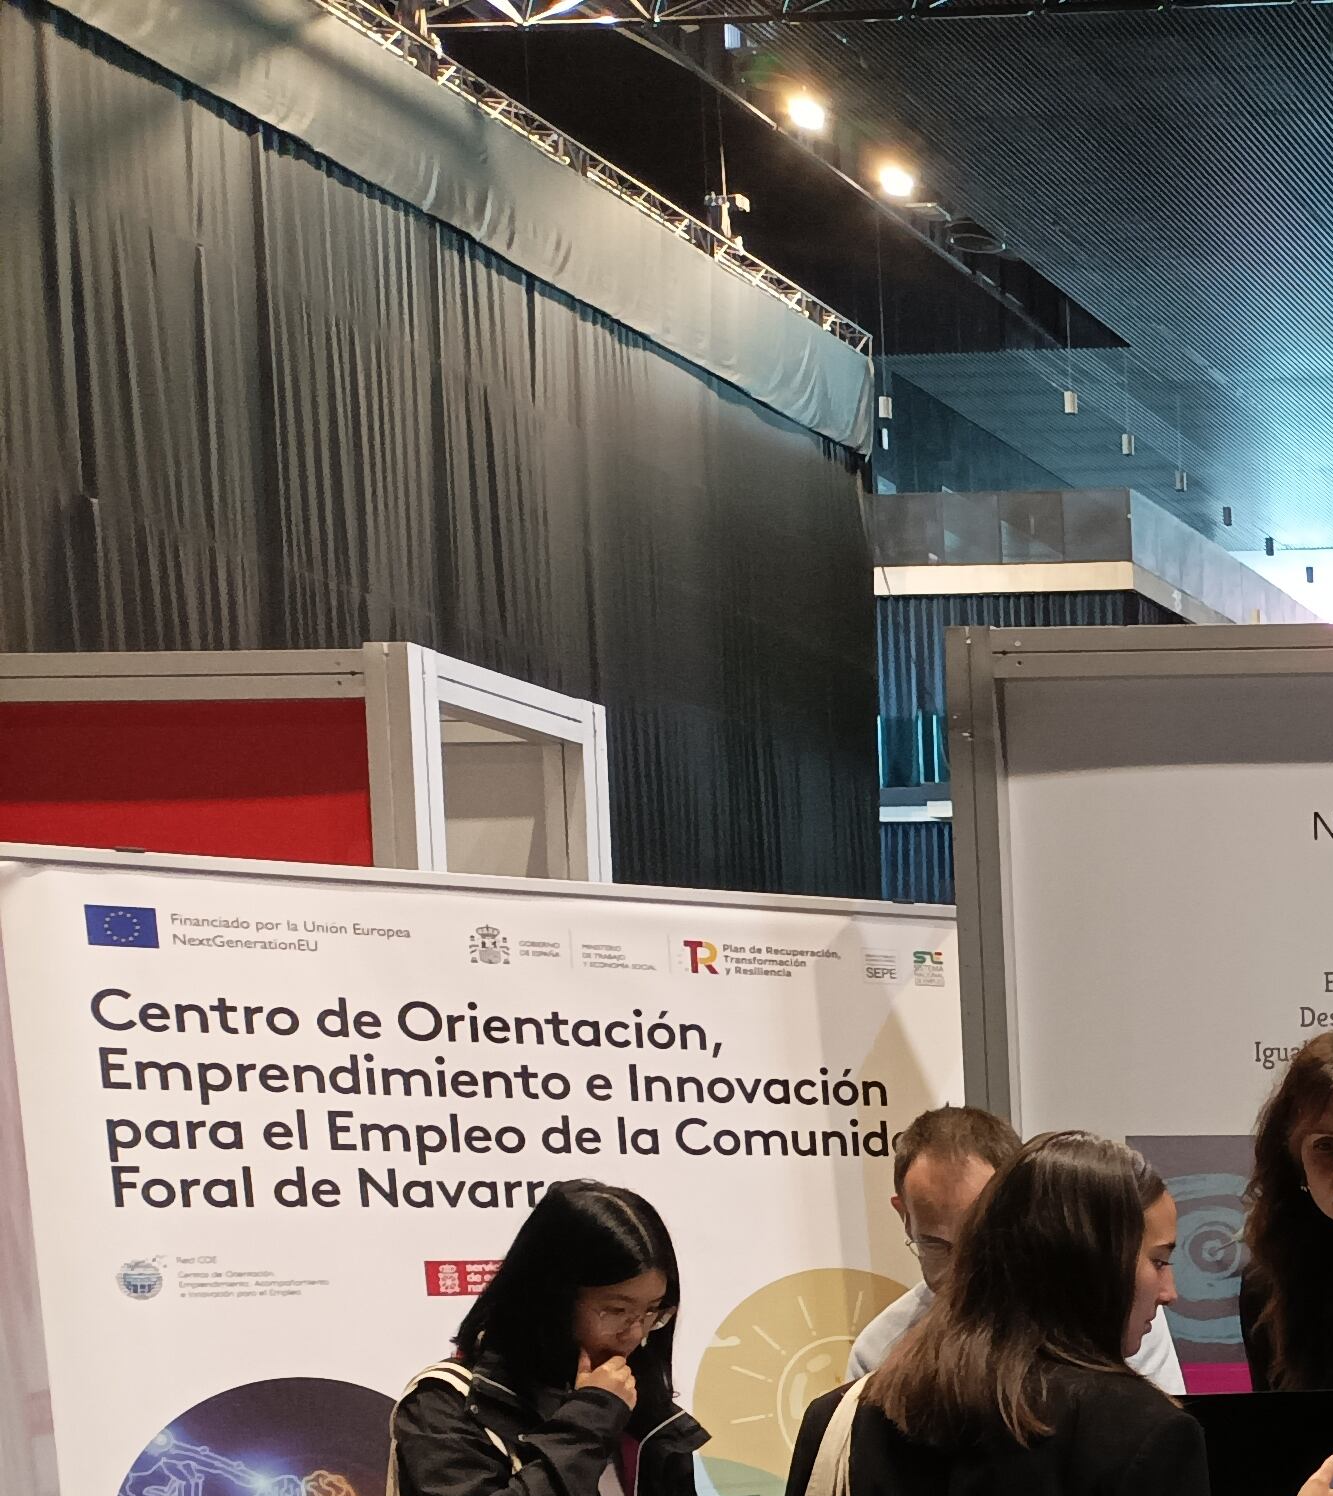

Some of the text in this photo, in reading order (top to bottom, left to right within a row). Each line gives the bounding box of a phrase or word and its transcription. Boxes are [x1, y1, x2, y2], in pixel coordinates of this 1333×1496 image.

[171, 913, 411, 939] Financiado por la Unión Europea
[172, 933, 318, 952] NextGenerationEU
[723, 944, 841, 959] Plan de Recuperación,
[724, 955, 806, 967] Transformación
[735, 967, 791, 977] Resiliencia
[866, 967, 896, 979] SEPE
[91, 989, 722, 1058] Centro de Orientación,
[1254, 1041, 1308, 1069] Igua
[99, 1046, 888, 1106] Emprendimiento e Innovación
[106, 1118, 243, 1162] para
[263, 1109, 308, 1150] el
[328, 1111, 526, 1165] Empleo
[542, 1115, 602, 1155] de
[618, 1116, 659, 1155] la
[111, 1166, 545, 1208] Foral de Navarr
